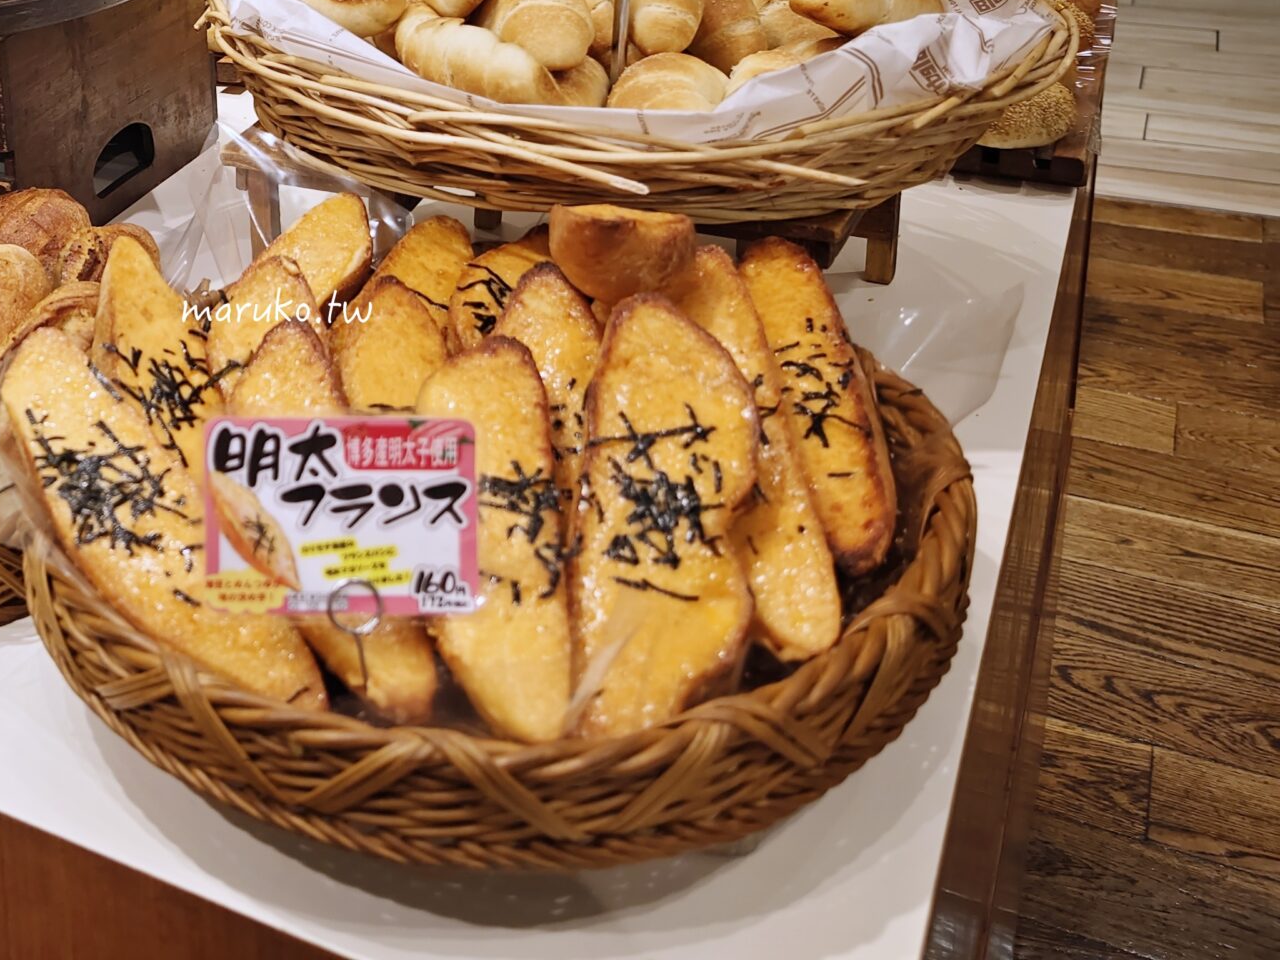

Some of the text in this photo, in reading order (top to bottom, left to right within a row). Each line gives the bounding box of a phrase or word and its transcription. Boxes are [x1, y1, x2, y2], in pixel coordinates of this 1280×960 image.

[213, 425, 338, 488] 明太
[281, 481, 468, 529] フランス
